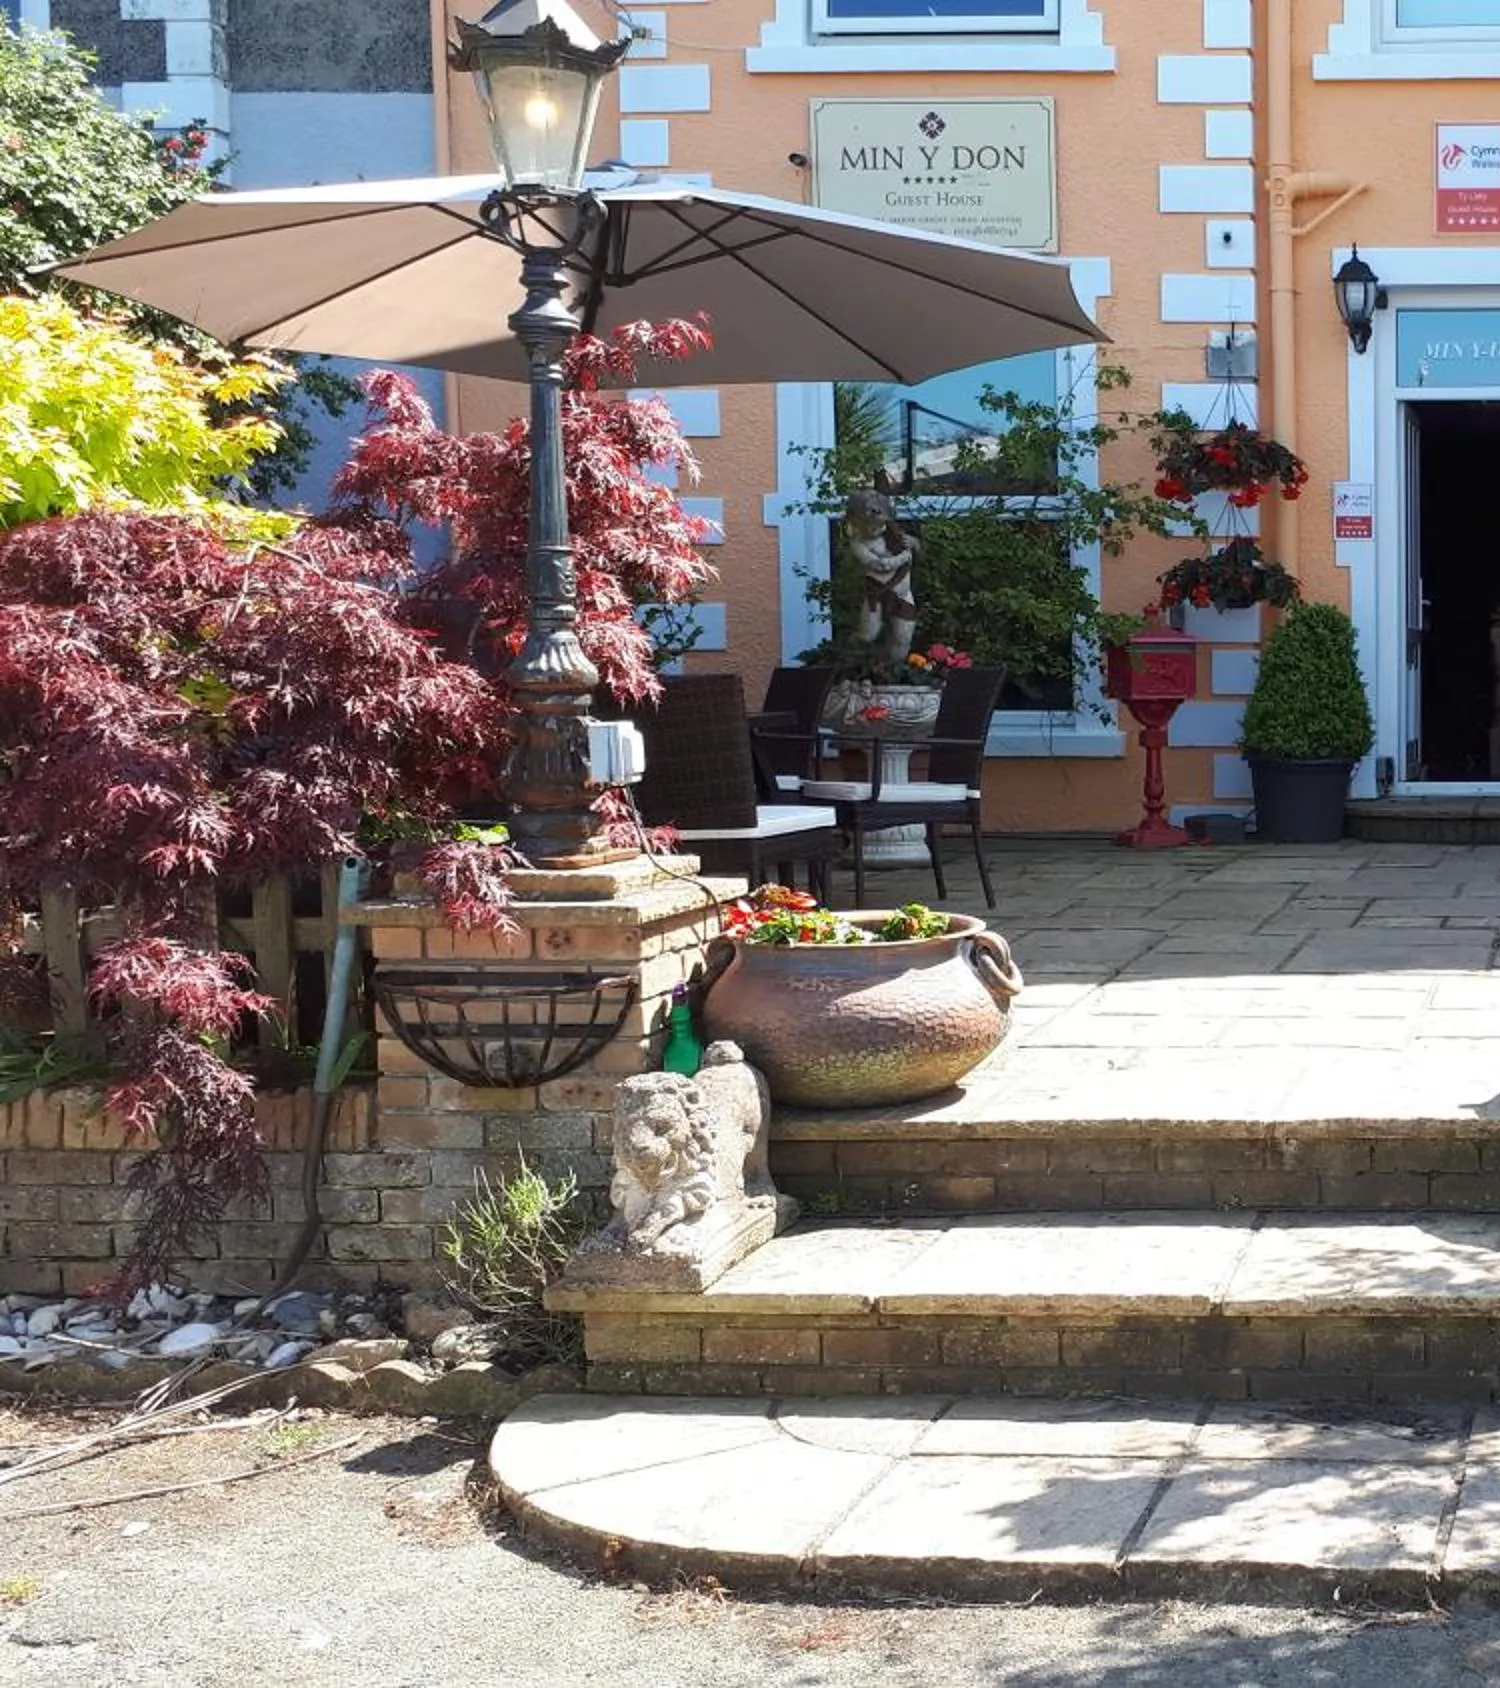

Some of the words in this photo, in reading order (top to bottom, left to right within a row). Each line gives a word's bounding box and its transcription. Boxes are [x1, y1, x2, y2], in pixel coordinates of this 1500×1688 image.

[840, 146, 904, 171] MIN
[919, 146, 939, 171] Y
[953, 145, 1026, 171] DON
[1424, 342, 1463, 359] MIN
